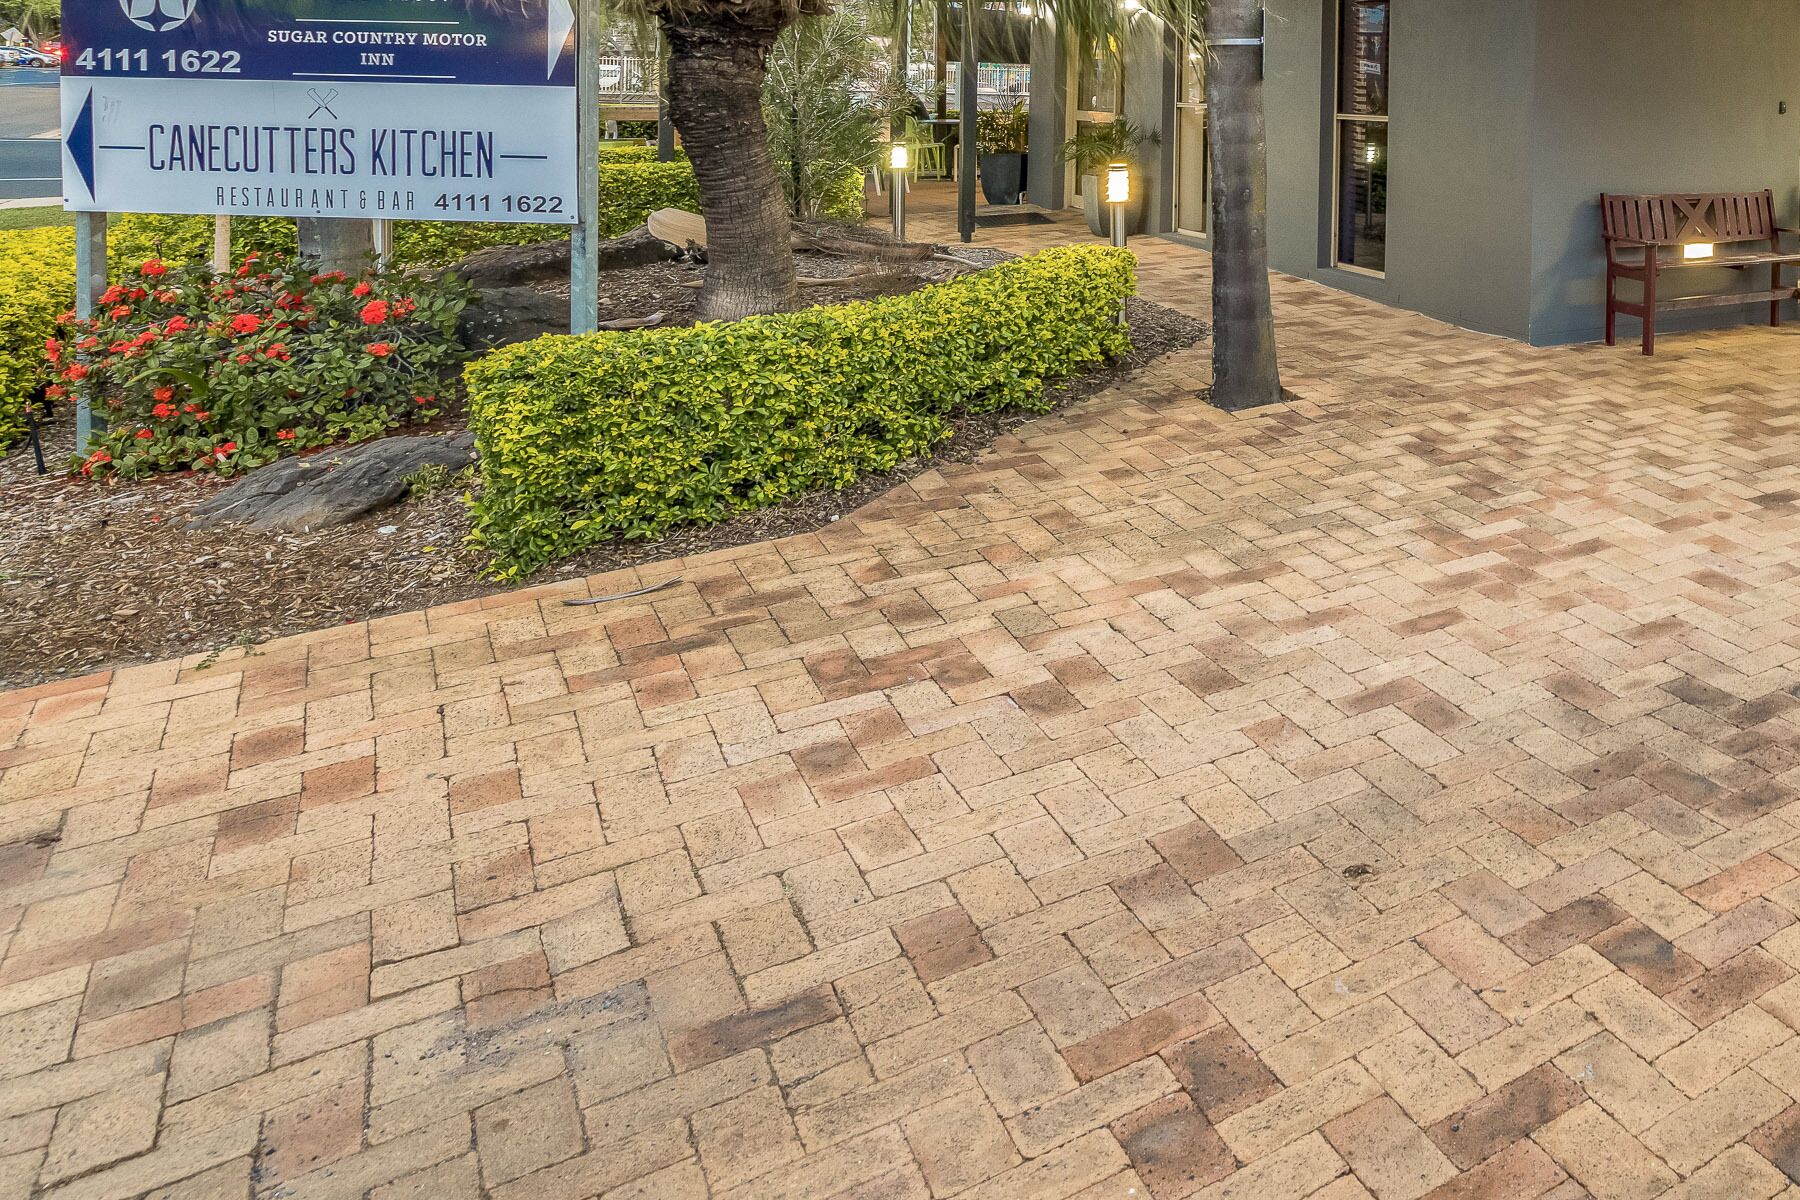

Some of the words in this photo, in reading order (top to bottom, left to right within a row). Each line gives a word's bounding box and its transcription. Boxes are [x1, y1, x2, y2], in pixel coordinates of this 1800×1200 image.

[268, 30, 328, 44] SUGAR
[332, 31, 418, 45] COUNTRY
[422, 33, 487, 47] MOTOR
[75, 48, 148, 71] 4111
[161, 49, 241, 73] 1622
[360, 53, 395, 66] INN
[149, 124, 356, 175] CANECUTTERS
[371, 128, 494, 179] KITCHEN
[216, 186, 349, 209] RESTAURANT
[359, 190, 367, 209] &
[377, 190, 415, 211] BAR
[434, 193, 492, 213] 4111
[501, 195, 564, 214] 1622
